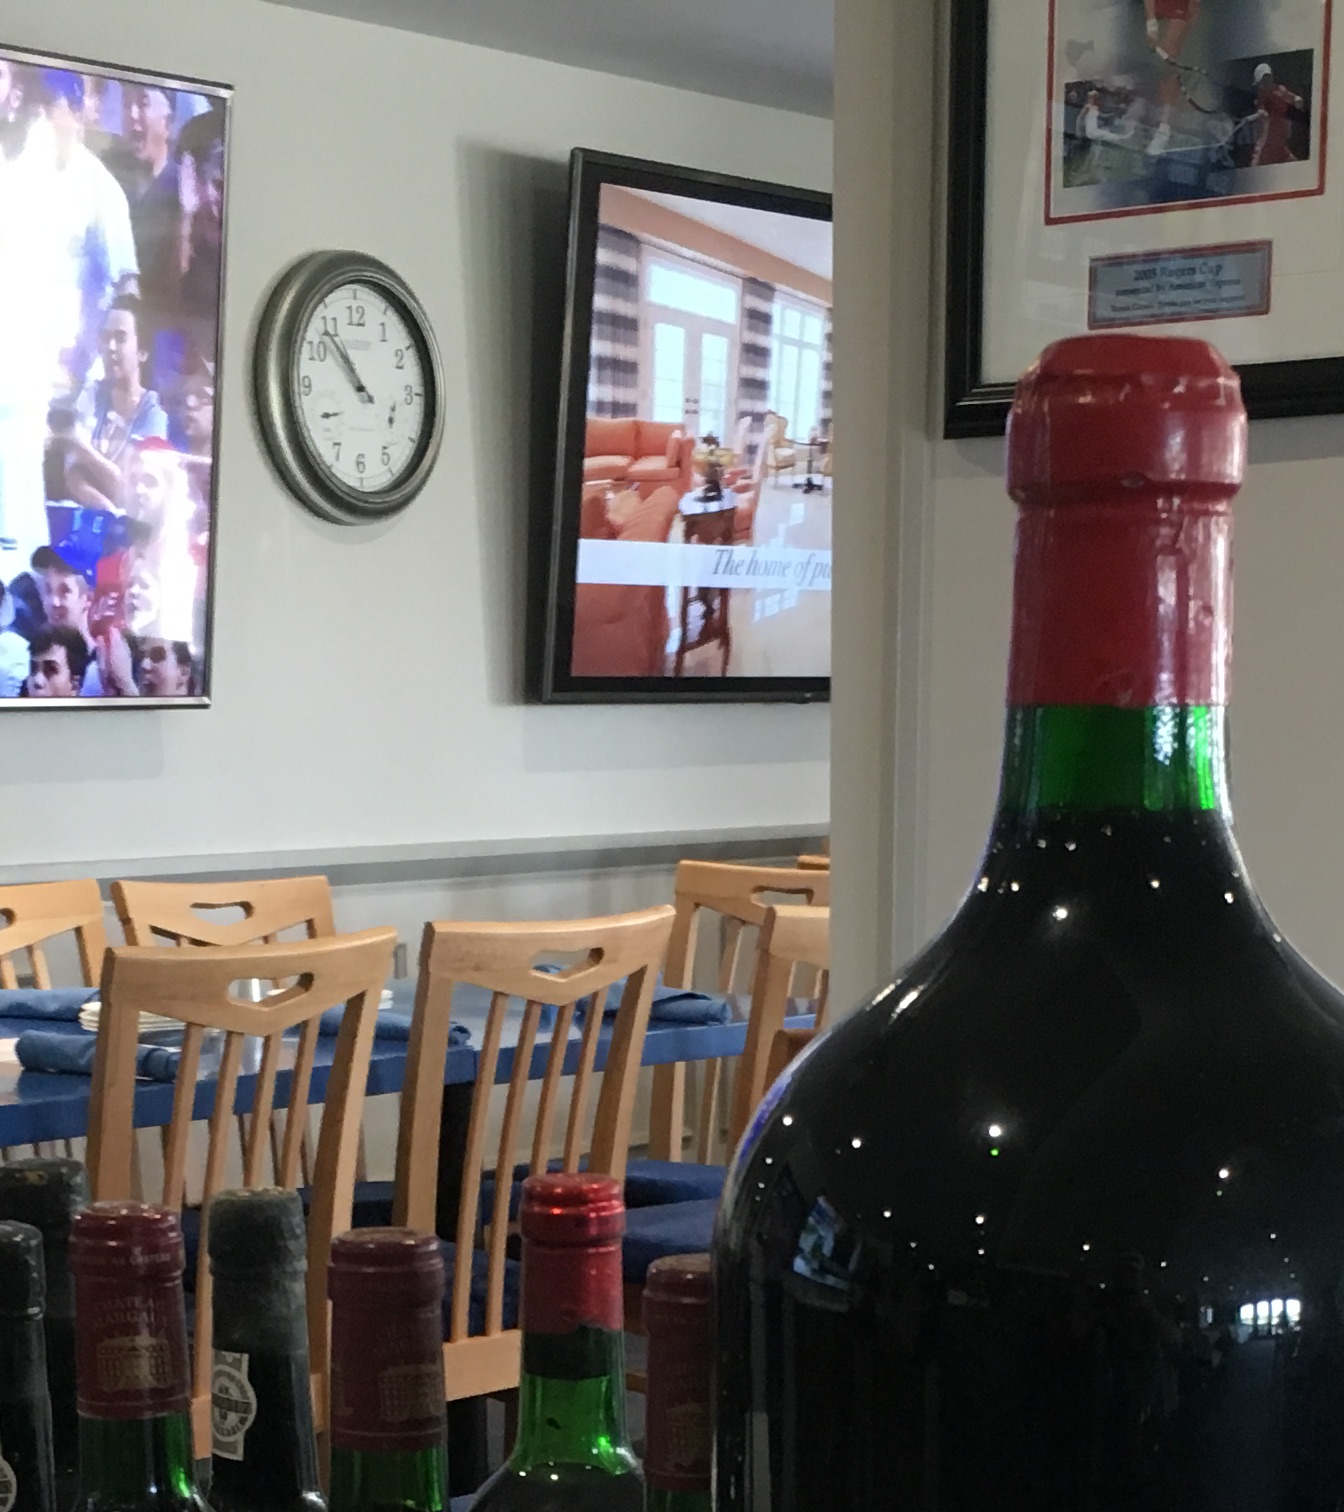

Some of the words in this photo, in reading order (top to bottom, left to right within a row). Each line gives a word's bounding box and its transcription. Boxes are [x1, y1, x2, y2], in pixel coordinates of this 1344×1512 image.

[346, 305, 366, 327] 12
[321, 316, 338, 337] 11
[379, 323, 388, 342] 1
[307, 341, 327, 362] 10
[395, 349, 404, 369] 2
[302, 376, 312, 396] 9
[404, 385, 414, 405] 3
[333, 442, 342, 462] 7
[381, 447, 390, 466] 5
[357, 454, 366, 473] 6
[713, 549, 744, 575] The
[746, 550, 791, 577] home
[794, 553, 816, 586] of
